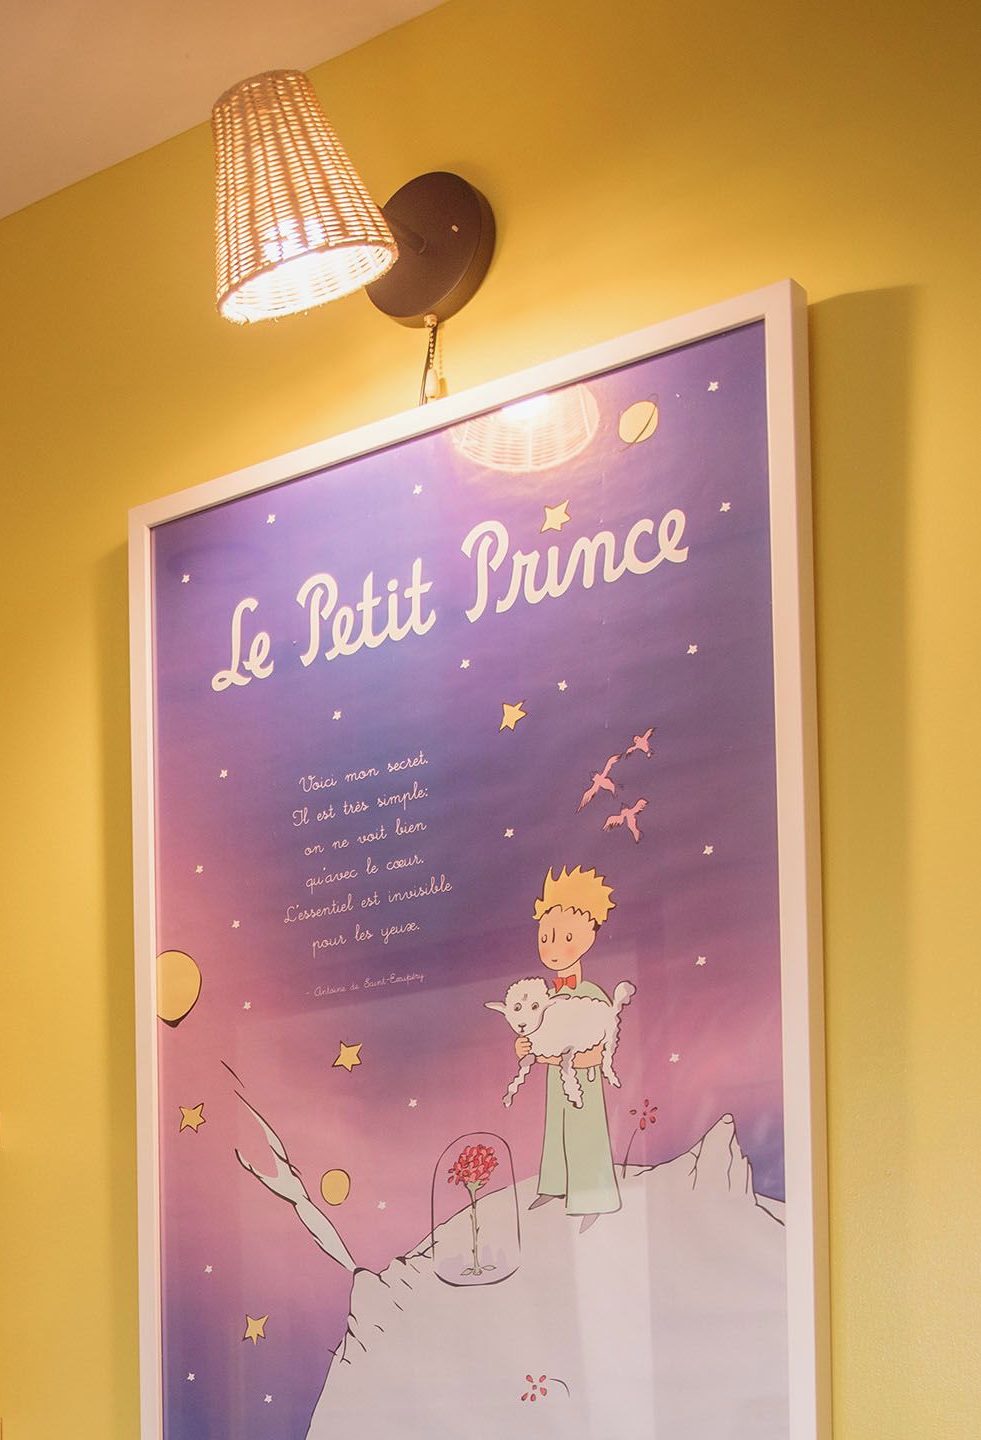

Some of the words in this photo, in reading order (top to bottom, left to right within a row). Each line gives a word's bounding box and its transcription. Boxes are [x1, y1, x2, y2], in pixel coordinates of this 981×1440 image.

[211, 598, 274, 691] Le
[296, 557, 437, 667] Petit
[461, 508, 689, 622] Prince
[299, 774, 338, 793] Voici
[345, 767, 380, 782] mon
[387, 750, 429, 773] secret.
[292, 807, 309, 827] Il
[316, 804, 335, 822] est
[343, 801, 369, 816] très
[377, 781, 429, 810] simple:
[304, 843, 324, 856] on
[332, 838, 349, 850] ne
[357, 825, 387, 843] voit
[395, 818, 427, 836] bien
[306, 867, 358, 894] qu'avec
[366, 857, 378, 874] le
[283, 893, 354, 924] L'essentiel
[361, 891, 380, 907] est
[388, 874, 453, 903] invisible
[312, 936, 347, 958] pour
[355, 924, 373, 941] les
[381, 920, 420, 944] yeux.
